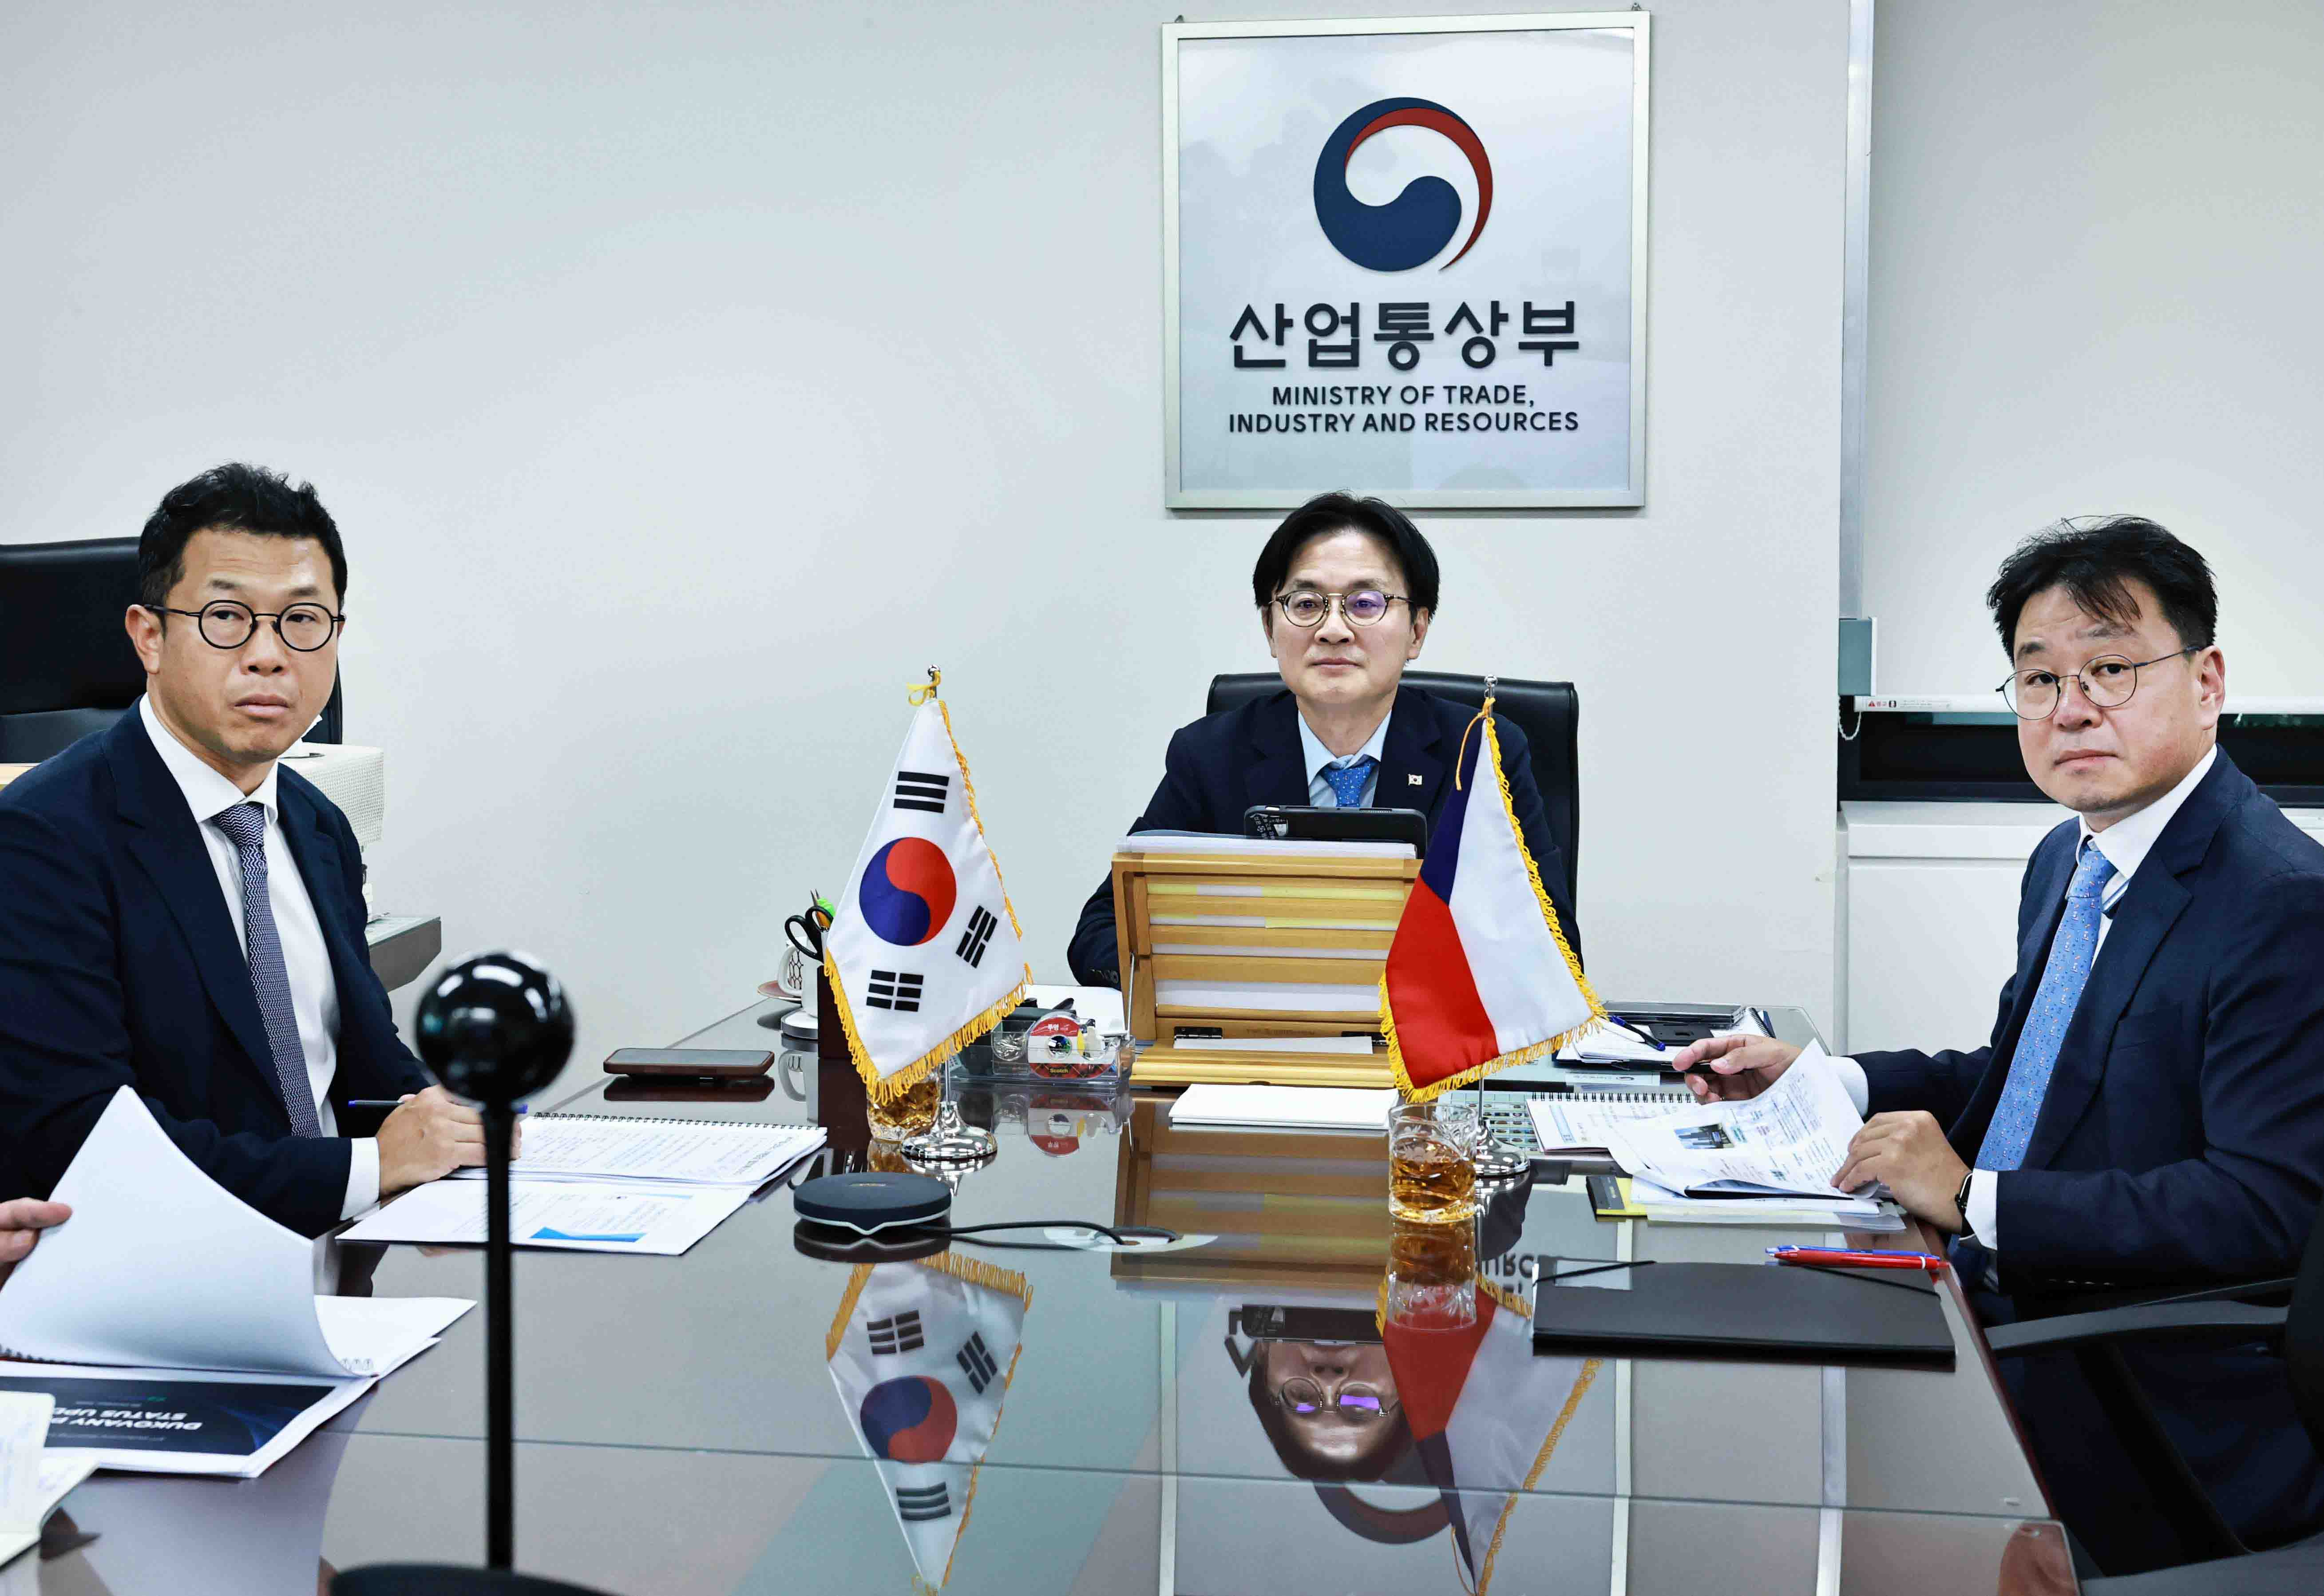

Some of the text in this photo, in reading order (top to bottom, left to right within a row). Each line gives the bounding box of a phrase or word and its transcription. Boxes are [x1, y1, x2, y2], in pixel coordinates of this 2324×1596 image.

[1229, 301, 1580, 372] 산업통상부
[1272, 385, 1534, 408] MINISTRY OF TRADE,
[1229, 412, 1579, 433] INDUSTRY AND RESOURCES
[68, 1417, 203, 1430] DUKOVANY
[100, 1409, 187, 1421] STATUS
